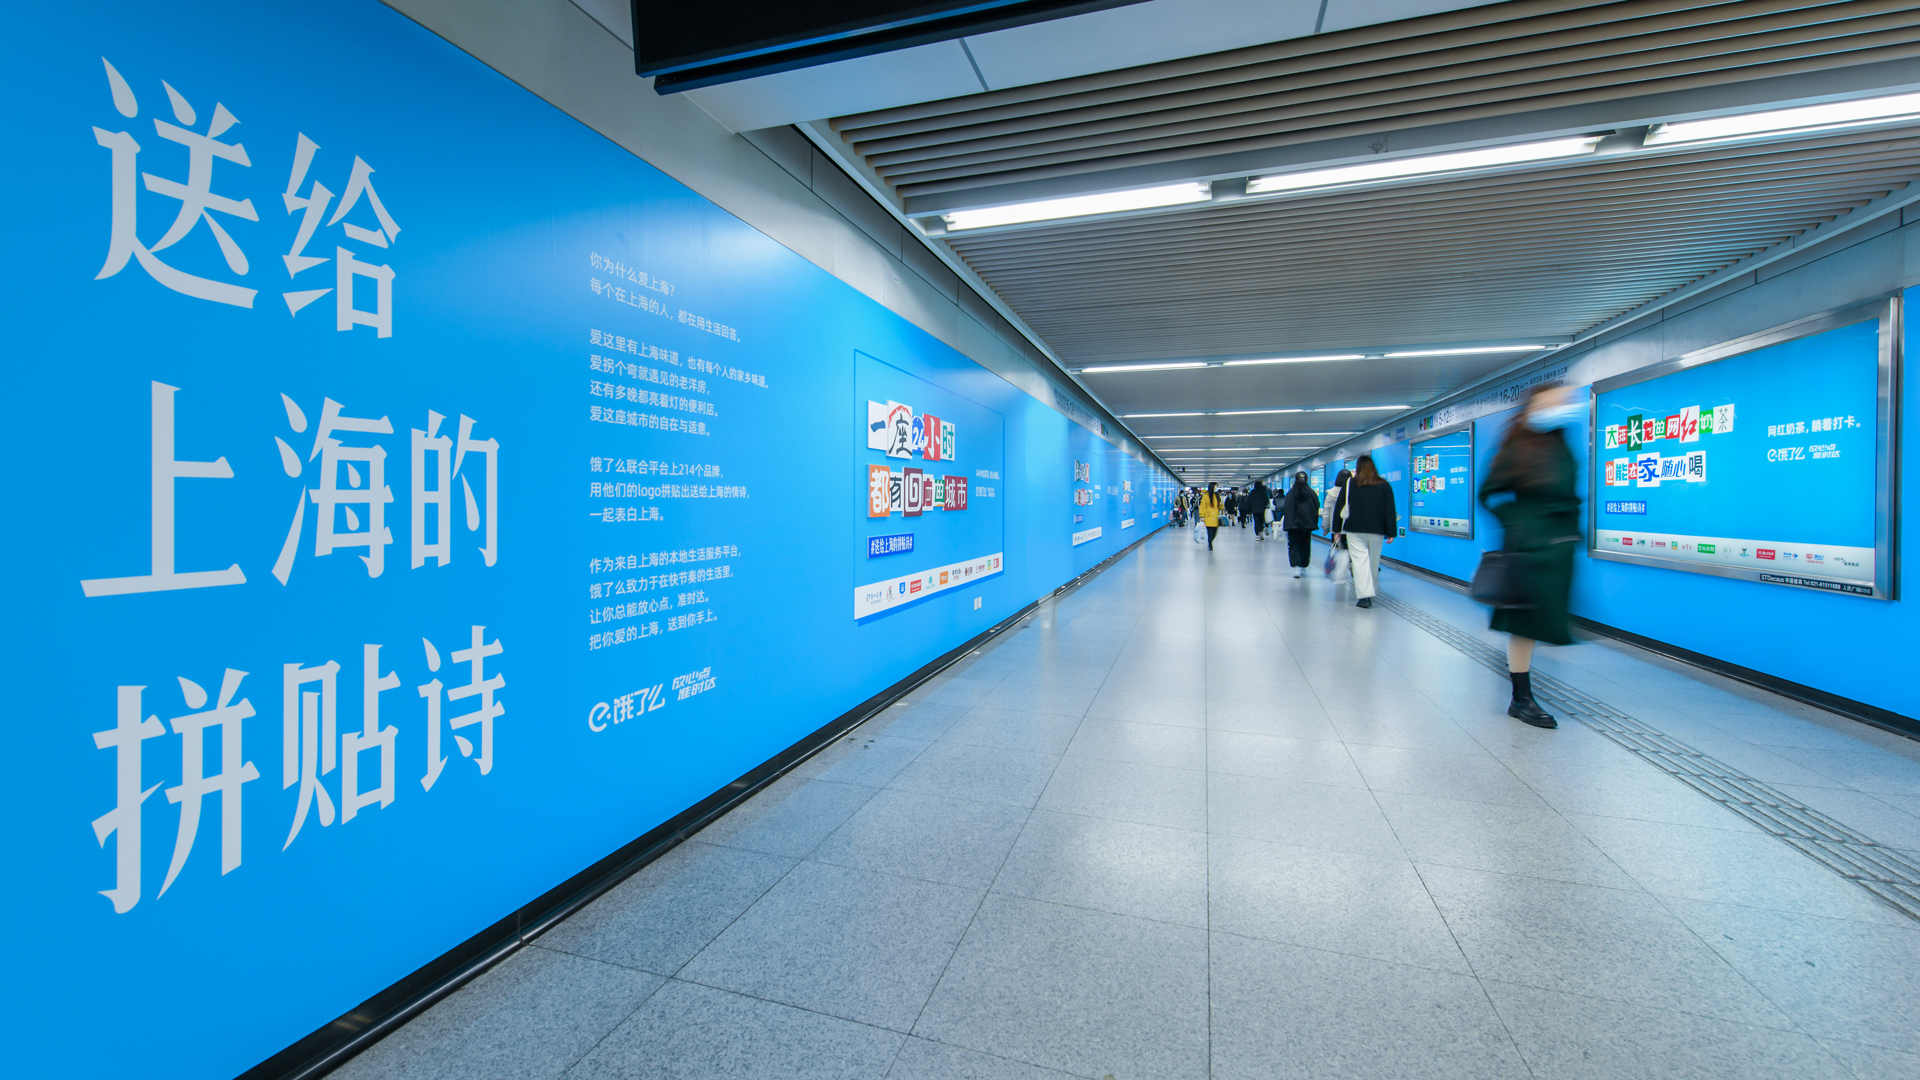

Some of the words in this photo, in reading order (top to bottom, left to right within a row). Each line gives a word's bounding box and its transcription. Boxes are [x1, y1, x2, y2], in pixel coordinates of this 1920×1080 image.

[91, 55, 402, 340] 送给
[1499, 384, 1520, 405] 16-20
[1605, 454, 1704, 484] 也能在家随心喝
[80, 380, 500, 598] 上海的
[589, 506, 664, 523] 一起表白上海。
[671, 666, 712, 691] 放心点
[677, 676, 717, 701] 准时达
[613, 683, 666, 725] 饿了么
[91, 625, 507, 915] 拼贴诗
